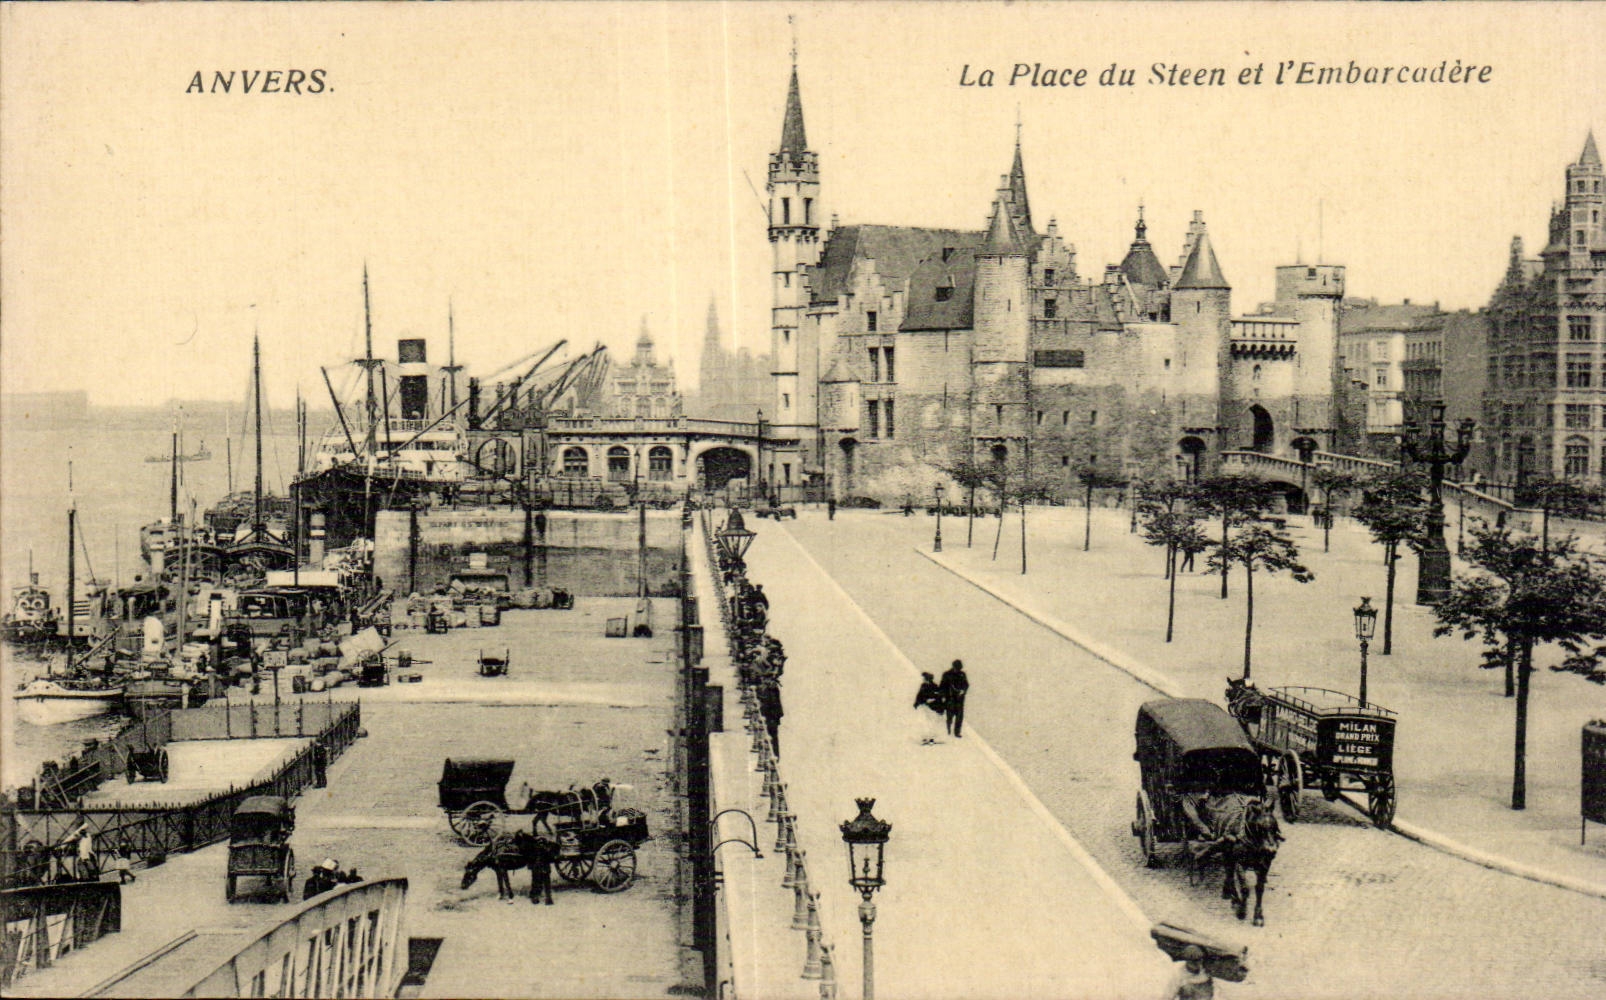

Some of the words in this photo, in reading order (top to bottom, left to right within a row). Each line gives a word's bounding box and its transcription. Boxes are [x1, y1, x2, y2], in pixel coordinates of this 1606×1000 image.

[1339, 721, 1377, 732] MILAN
[1335, 732, 1360, 741] GRAND
[1360, 733, 1380, 743] PRIX
